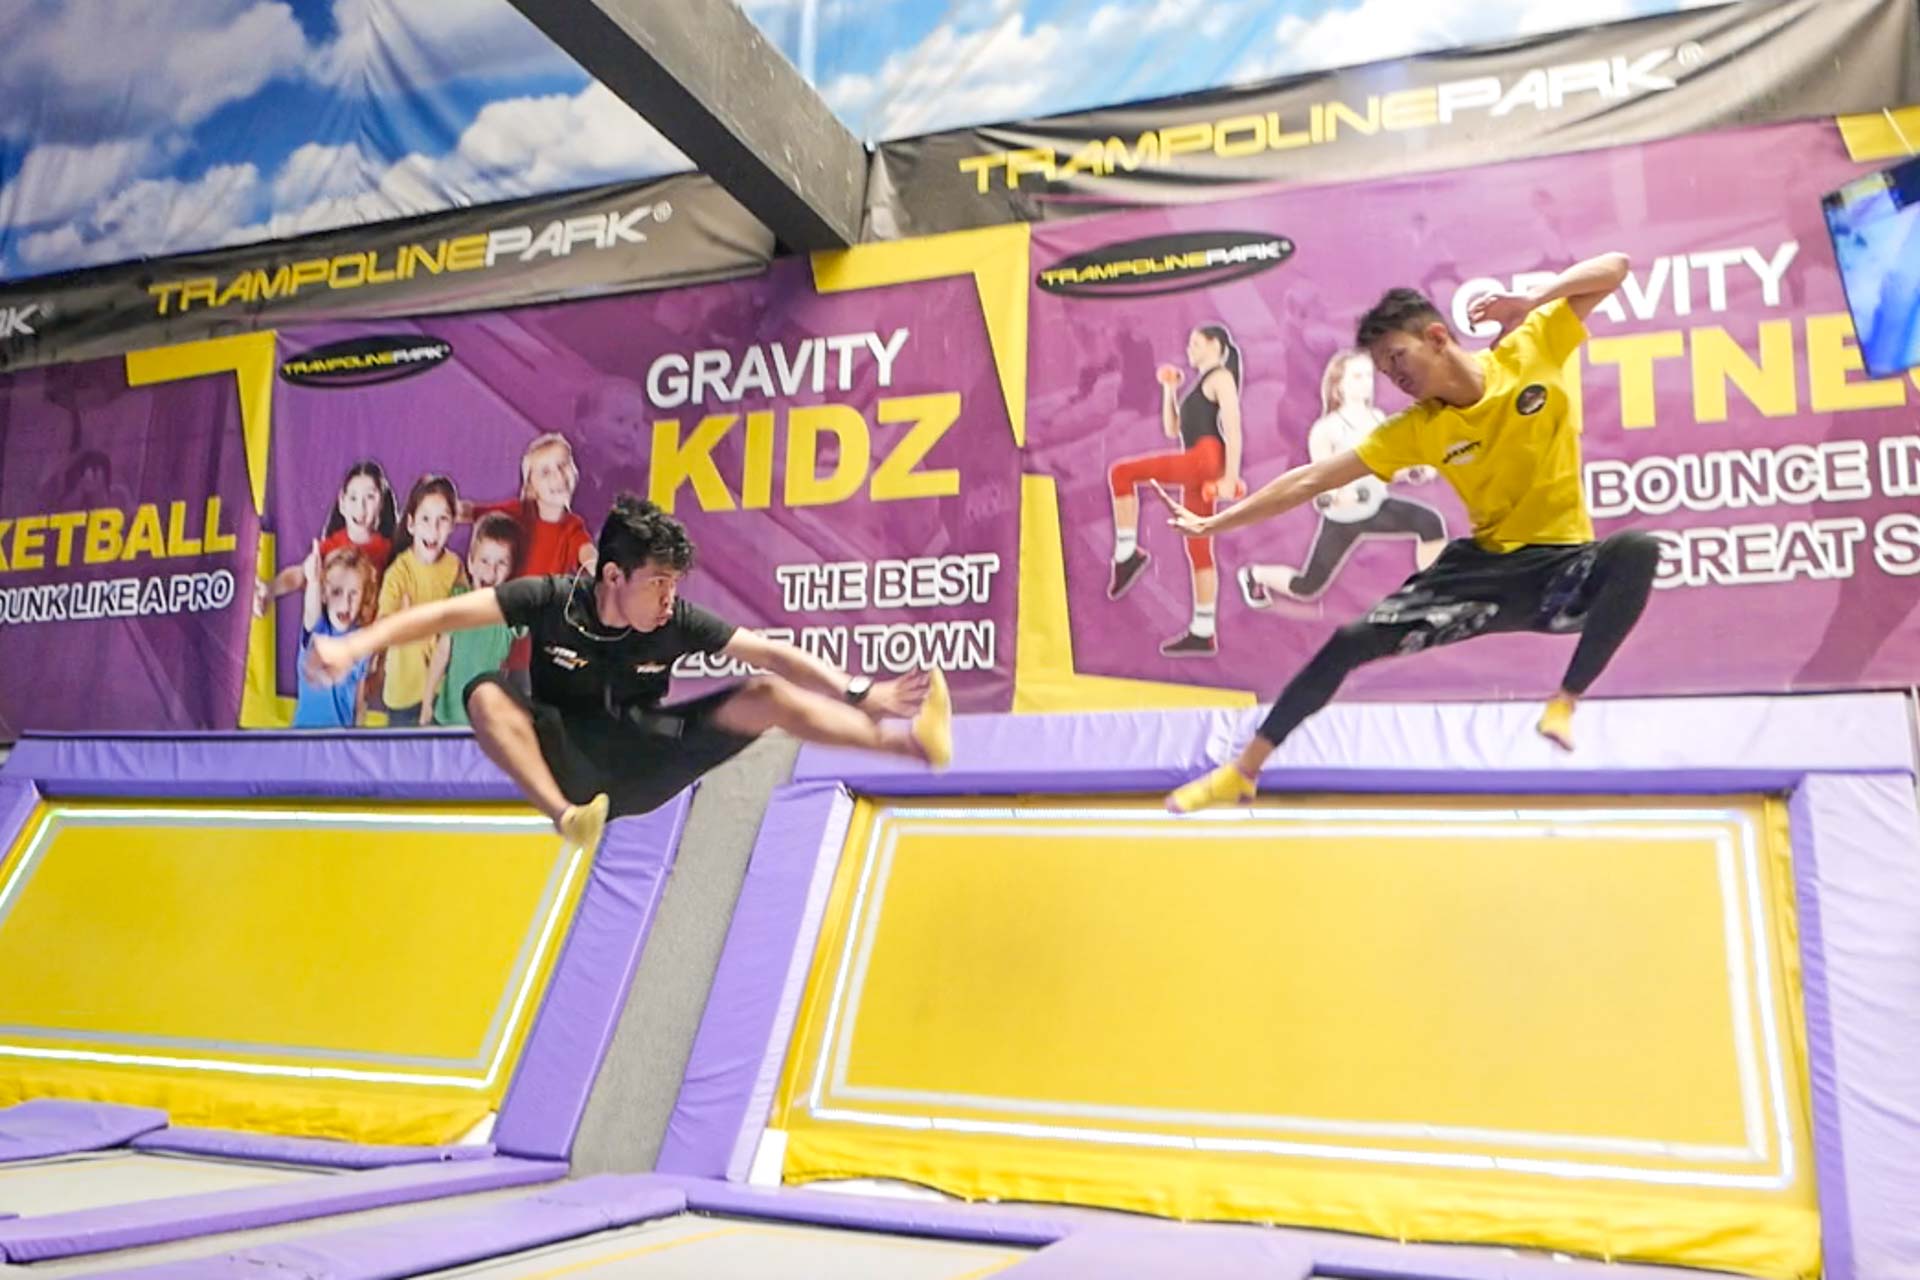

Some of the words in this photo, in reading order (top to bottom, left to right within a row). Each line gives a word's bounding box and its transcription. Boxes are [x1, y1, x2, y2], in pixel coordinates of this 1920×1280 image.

[959, 46, 1678, 194] TRAMPOLINEPARK
[148, 206, 651, 315] TRAMPOLINEPARK
[646, 328, 909, 408] GRAVITY
[649, 391, 962, 516] KIDZ
[1585, 442, 1872, 517] BOUNCE
[70, 578, 139, 619] LIKE
[140, 577, 167, 613] A
[168, 569, 235, 610] PRO
[776, 562, 871, 612] THE
[873, 553, 999, 608] BEST
[853, 620, 995, 671] TOWN
